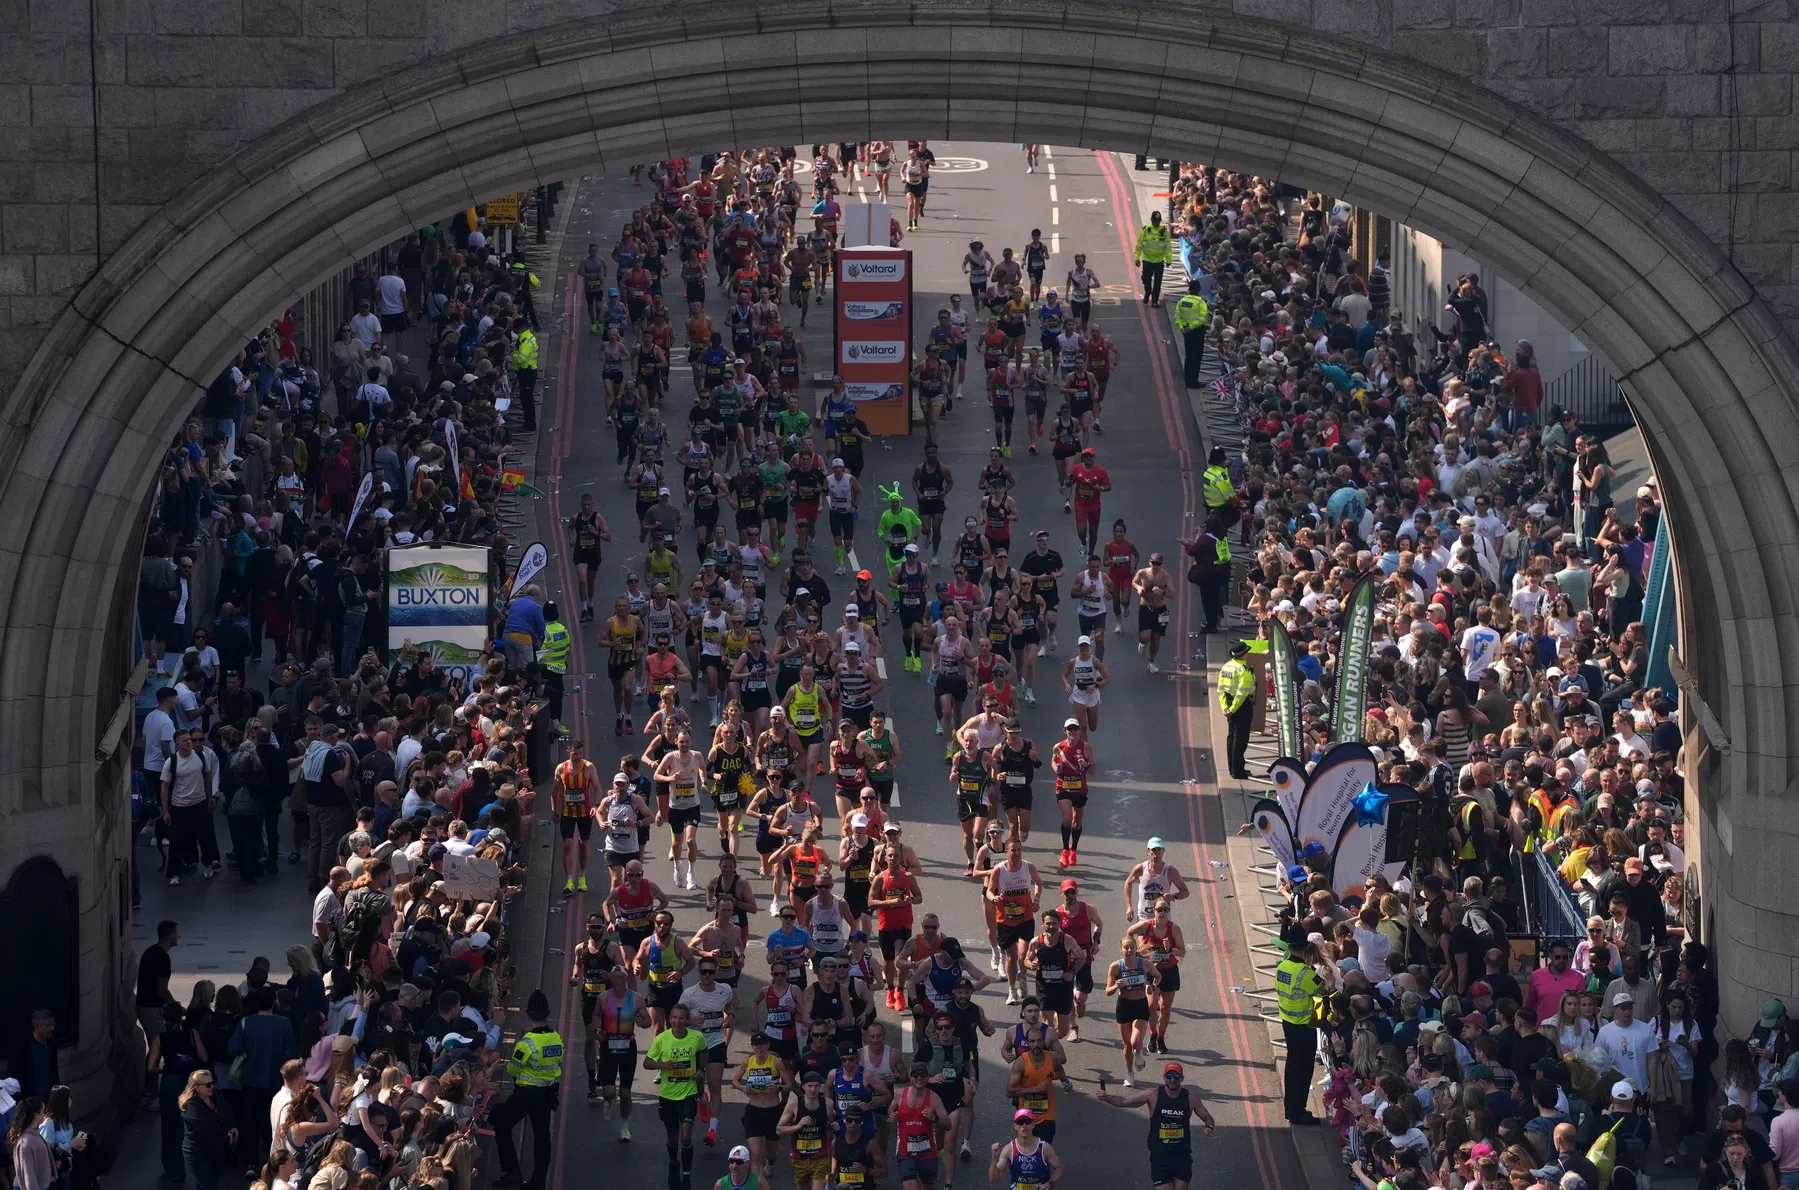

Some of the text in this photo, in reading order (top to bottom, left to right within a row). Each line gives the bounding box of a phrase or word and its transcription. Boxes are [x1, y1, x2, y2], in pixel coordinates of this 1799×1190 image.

[860, 264, 896, 273] Voltarol
[860, 345, 896, 354] Voltarol
[397, 588, 480, 605] BUXTON
[1339, 631, 1347, 657] Runners
[1346, 604, 1368, 692] RUNNERS
[1336, 658, 1344, 677] Vegan
[721, 758, 742, 769] DAC
[1317, 766, 1357, 831] Royal Hospital for
[1327, 778, 1362, 837] Neuro-disability
[1004, 888, 1029, 896] JOHNNY
[1018, 1155, 1037, 1163] NICK
